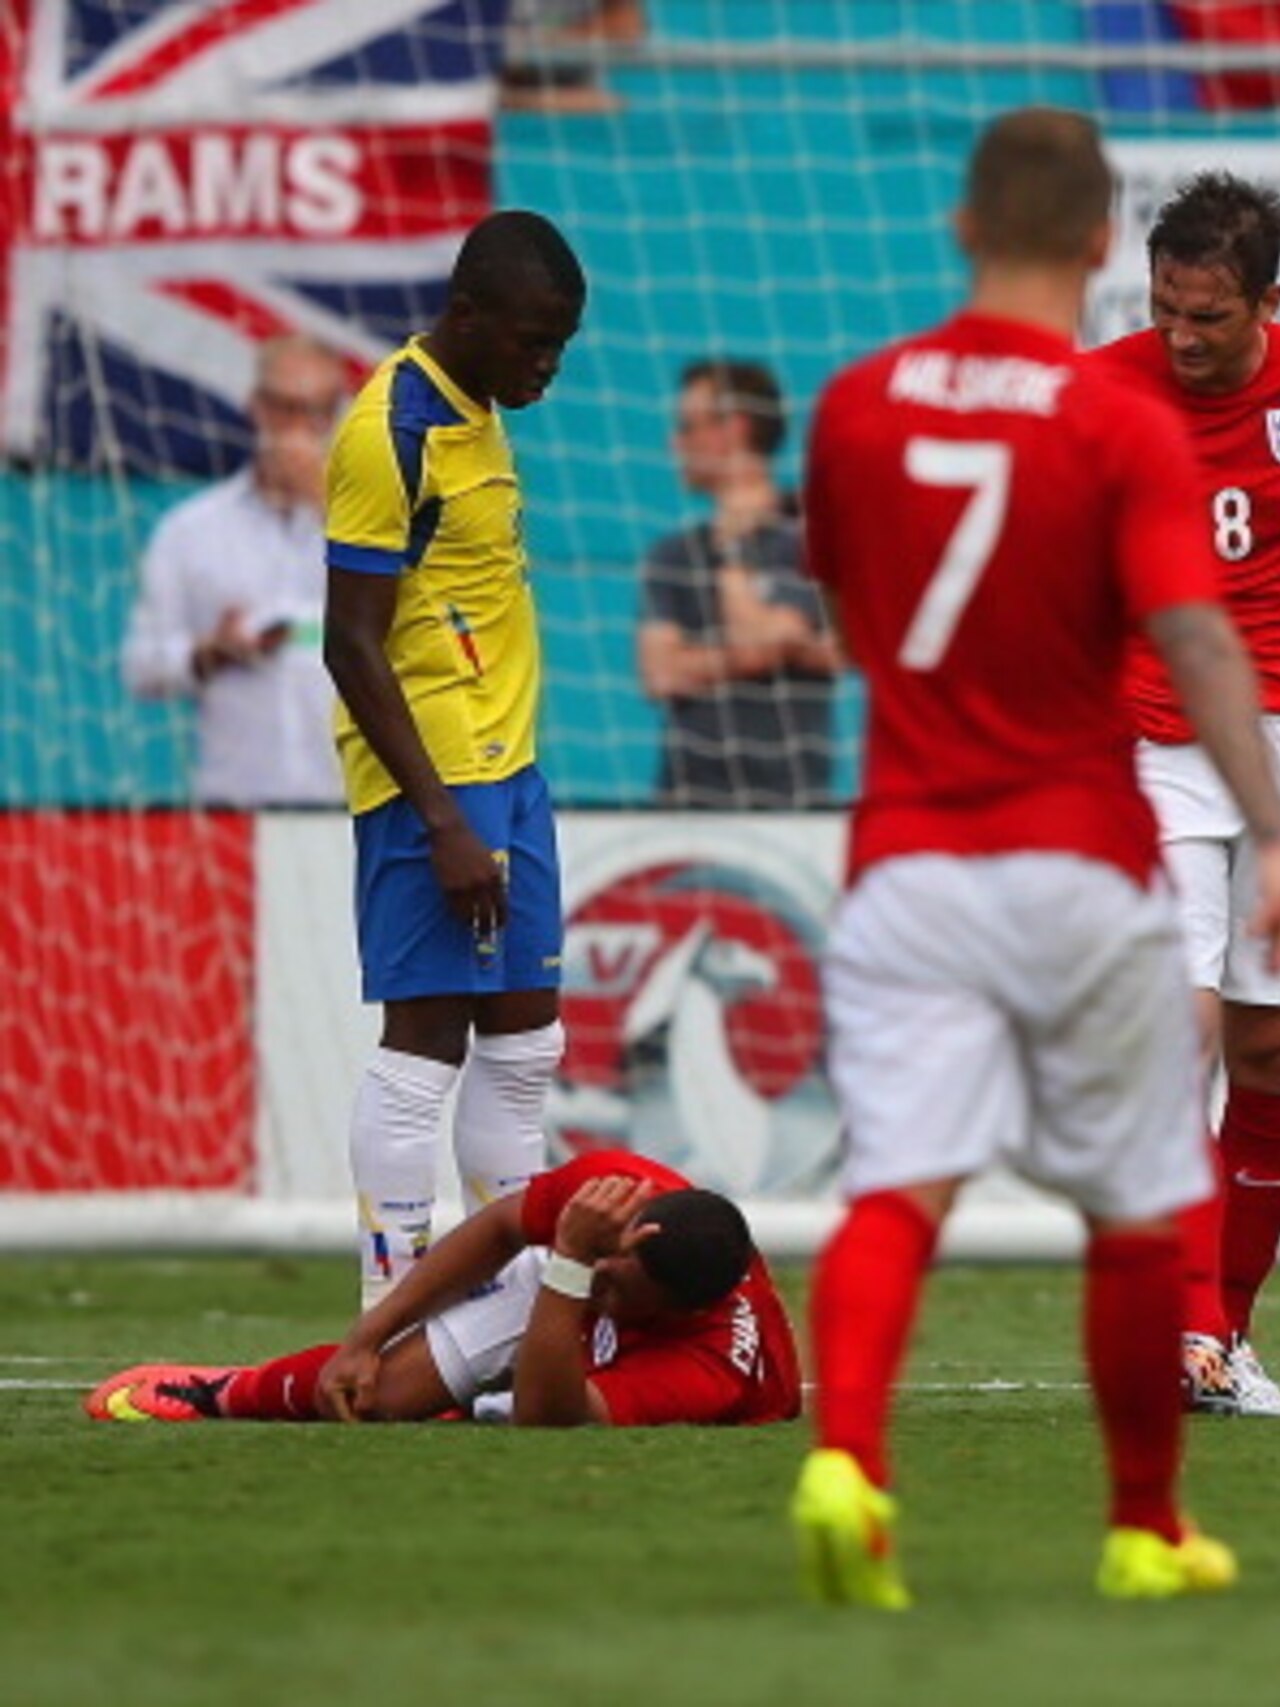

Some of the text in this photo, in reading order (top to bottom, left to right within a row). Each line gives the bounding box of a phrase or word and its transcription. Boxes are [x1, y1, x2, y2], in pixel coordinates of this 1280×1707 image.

[34, 136, 364, 236] RAMS
[899, 436, 1014, 672] 7
[1213, 486, 1252, 561] 8
